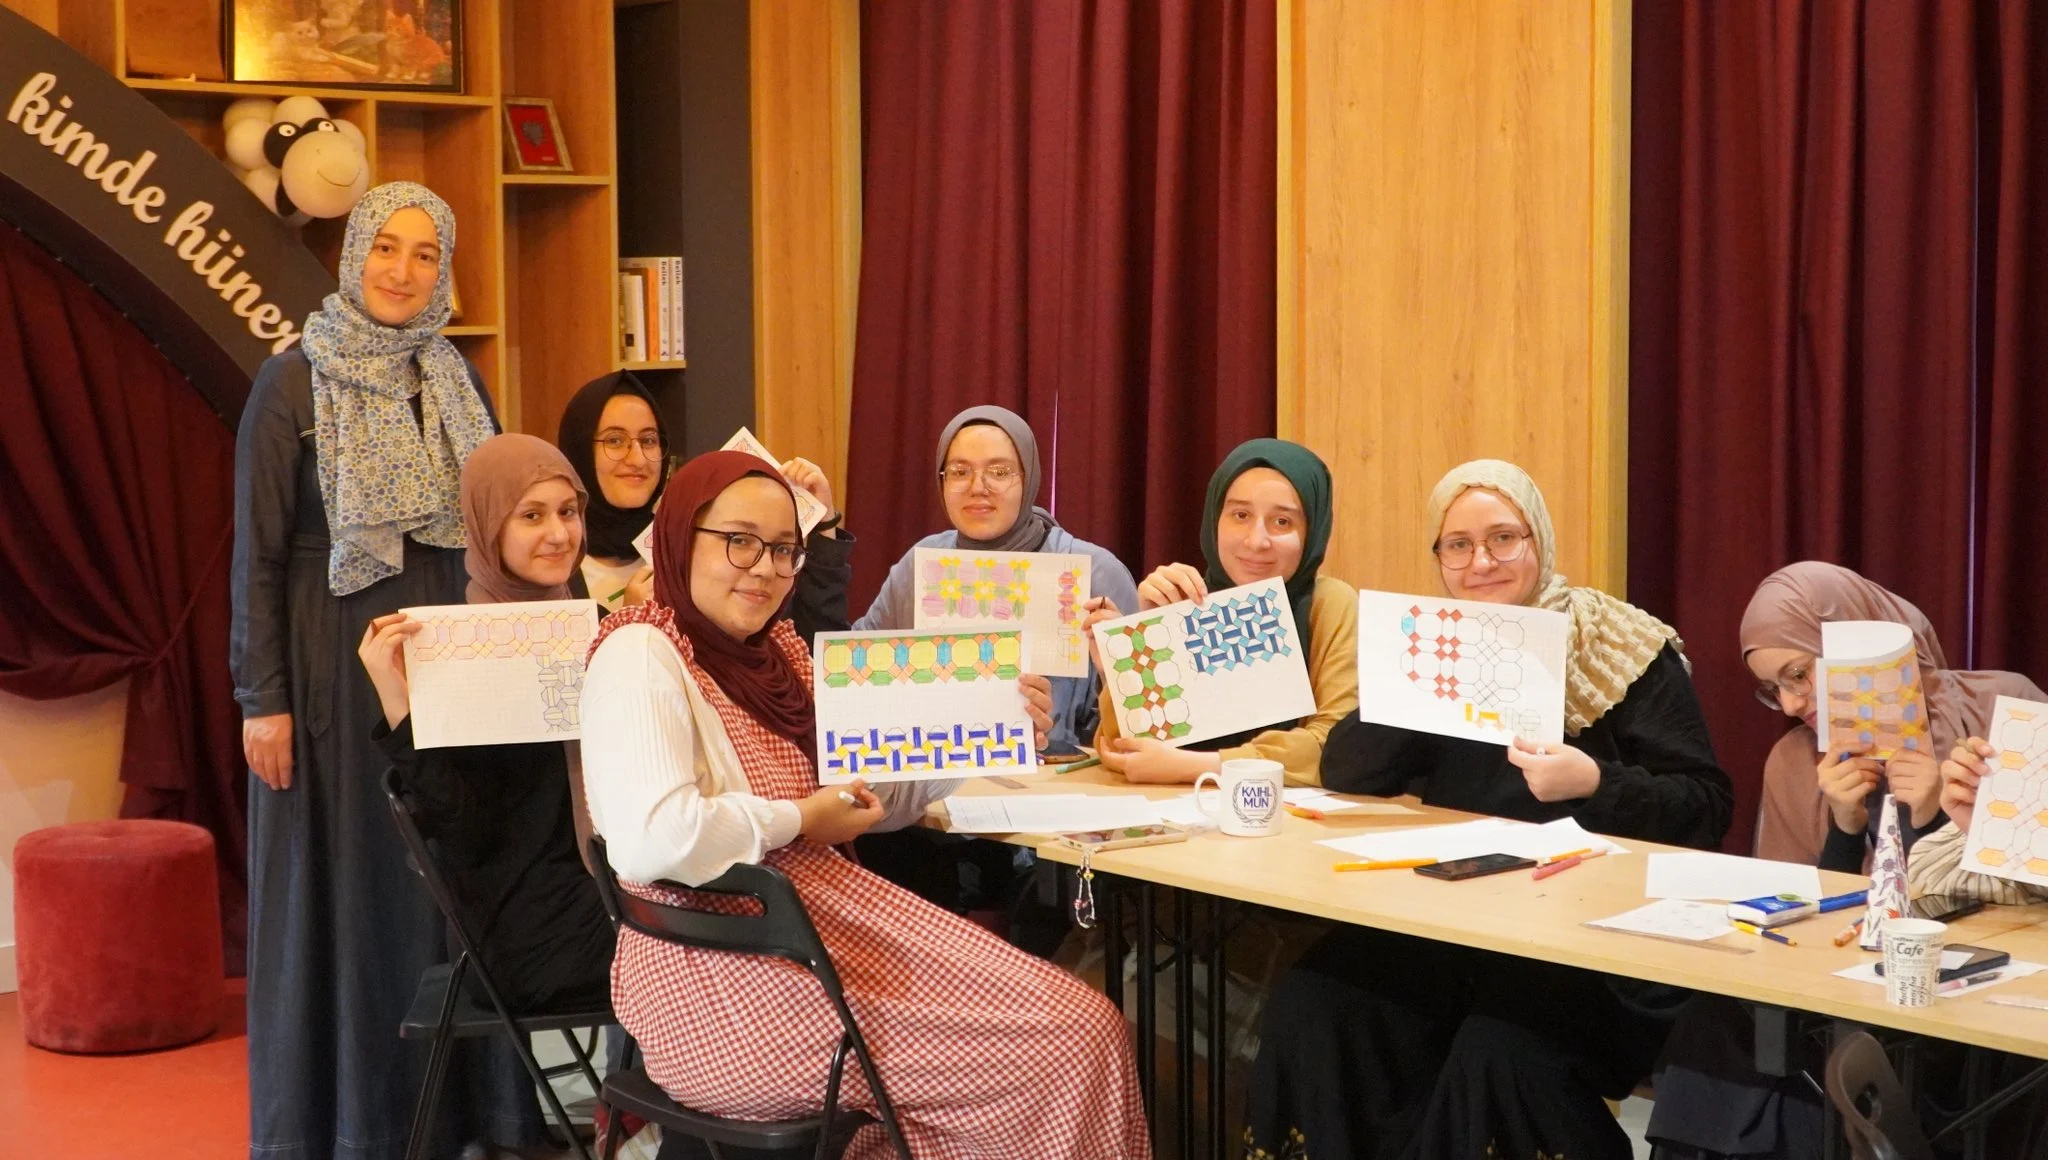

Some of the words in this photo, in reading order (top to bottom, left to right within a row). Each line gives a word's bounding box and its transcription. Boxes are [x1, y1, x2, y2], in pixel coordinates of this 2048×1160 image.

[7, 72, 165, 223] kimde
[1243, 797, 1269, 809] MUN
[1896, 942, 1924, 957] Cafe
[1898, 980, 1909, 1006] Mocha
